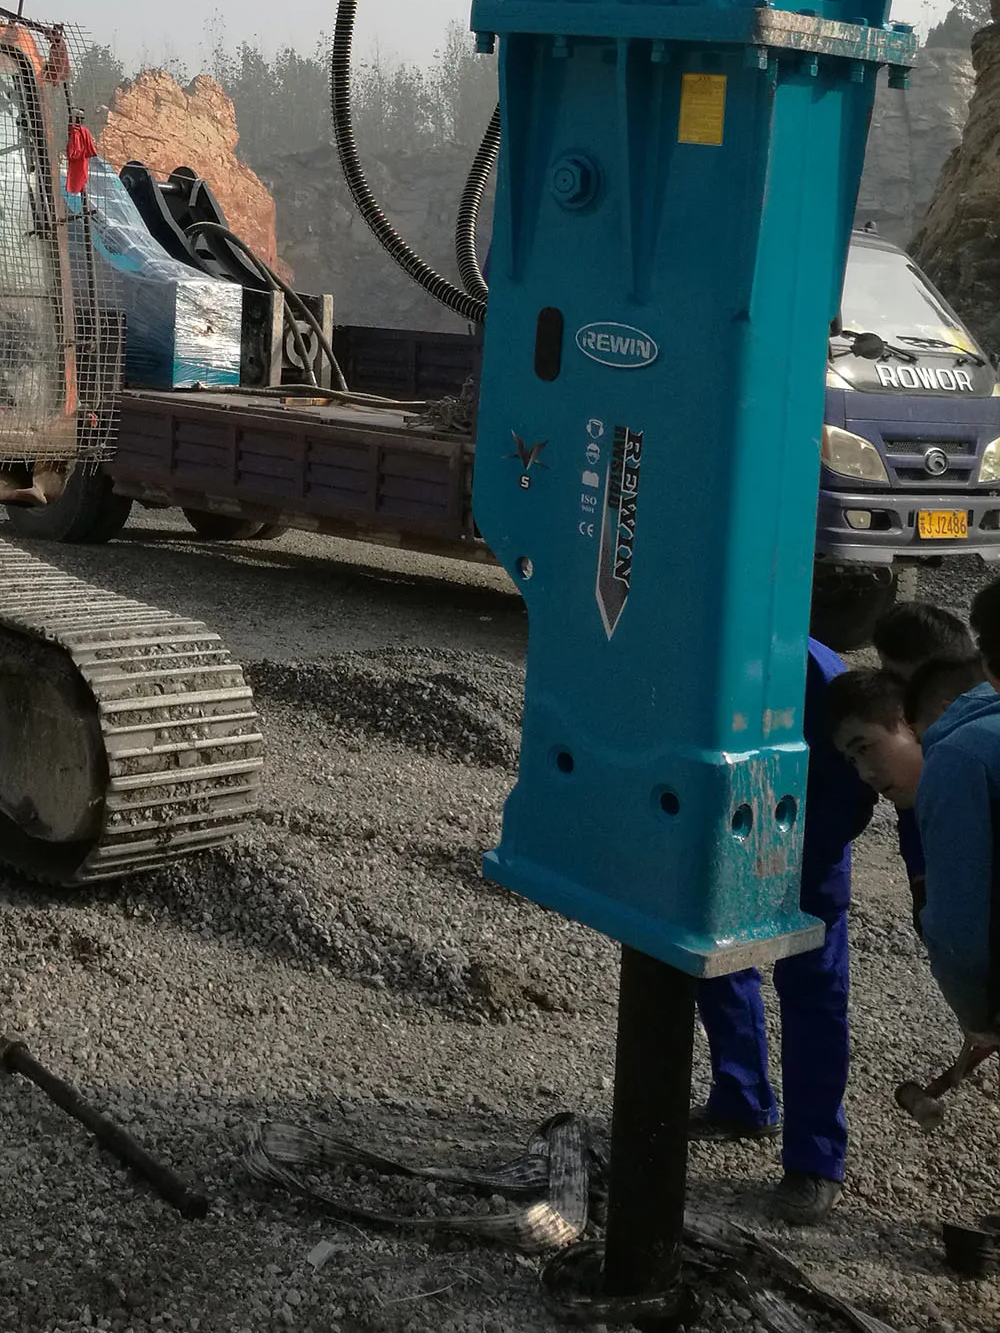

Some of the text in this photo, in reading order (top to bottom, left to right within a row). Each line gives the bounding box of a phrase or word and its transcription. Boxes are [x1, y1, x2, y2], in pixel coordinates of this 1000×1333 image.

[581, 330, 651, 359] REWIN
[875, 365, 974, 392] ROWOR
[581, 493, 597, 506] ISO
[612, 427, 644, 588] REWIN
